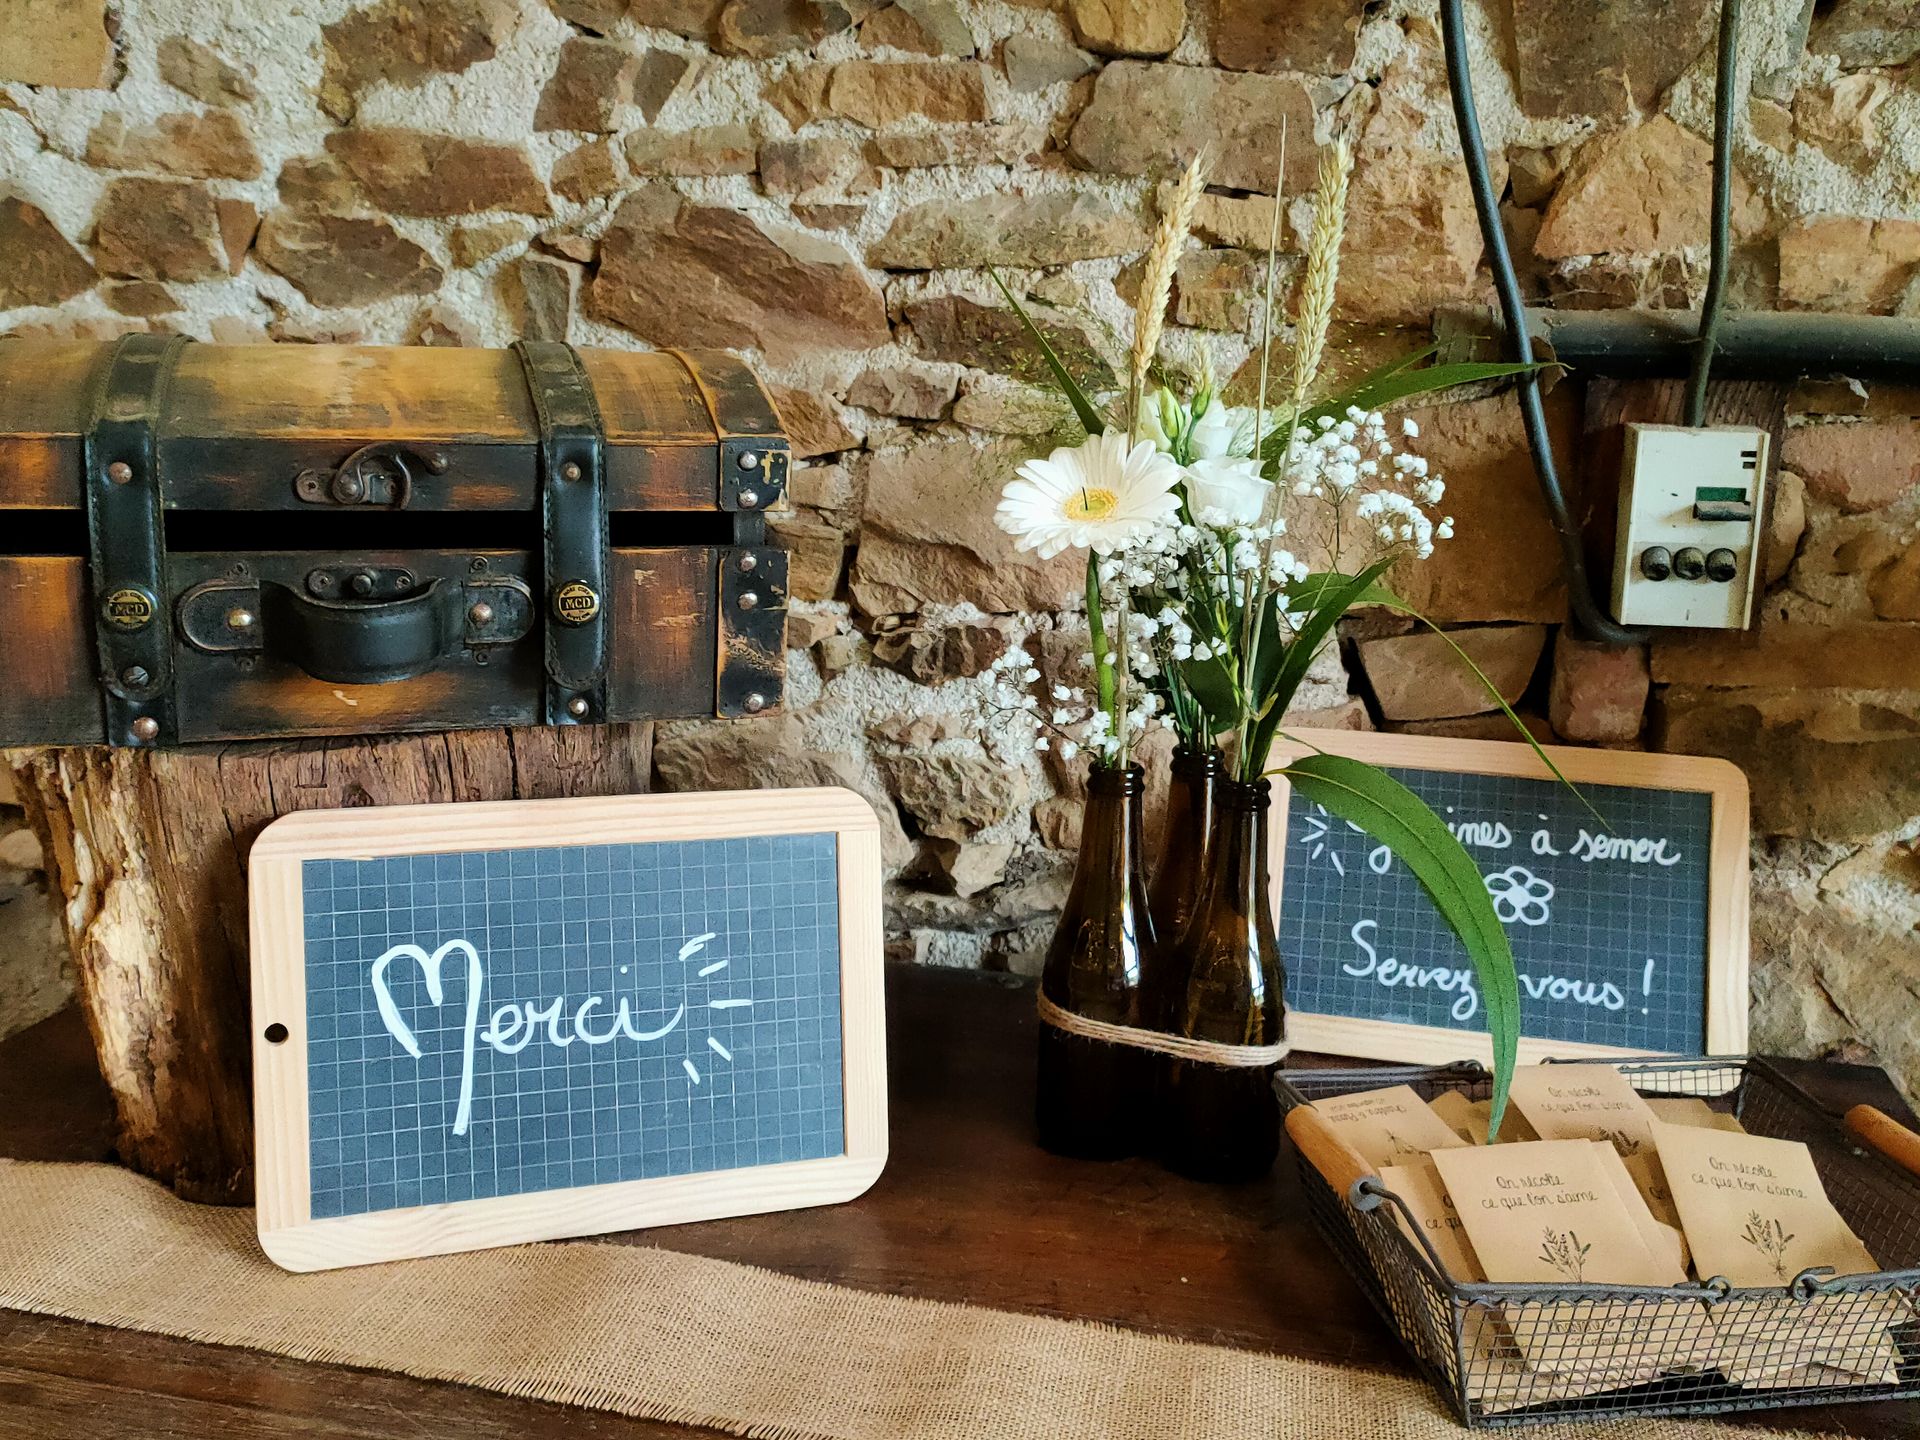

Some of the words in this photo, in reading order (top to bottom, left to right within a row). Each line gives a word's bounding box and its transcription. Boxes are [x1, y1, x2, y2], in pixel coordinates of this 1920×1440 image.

[564, 596, 591, 609] MCD
[1531, 813, 1560, 856] à
[1569, 828, 1682, 867] semer
[1342, 919, 1479, 1021] Servez
[1518, 973, 1625, 1011] vous
[1641, 958, 1656, 1015] !
[370, 938, 685, 1137] Merci
[1495, 1175, 1520, 1189] On
[1481, 1197, 1499, 1209] ce
[1500, 1194, 1528, 1211] que
